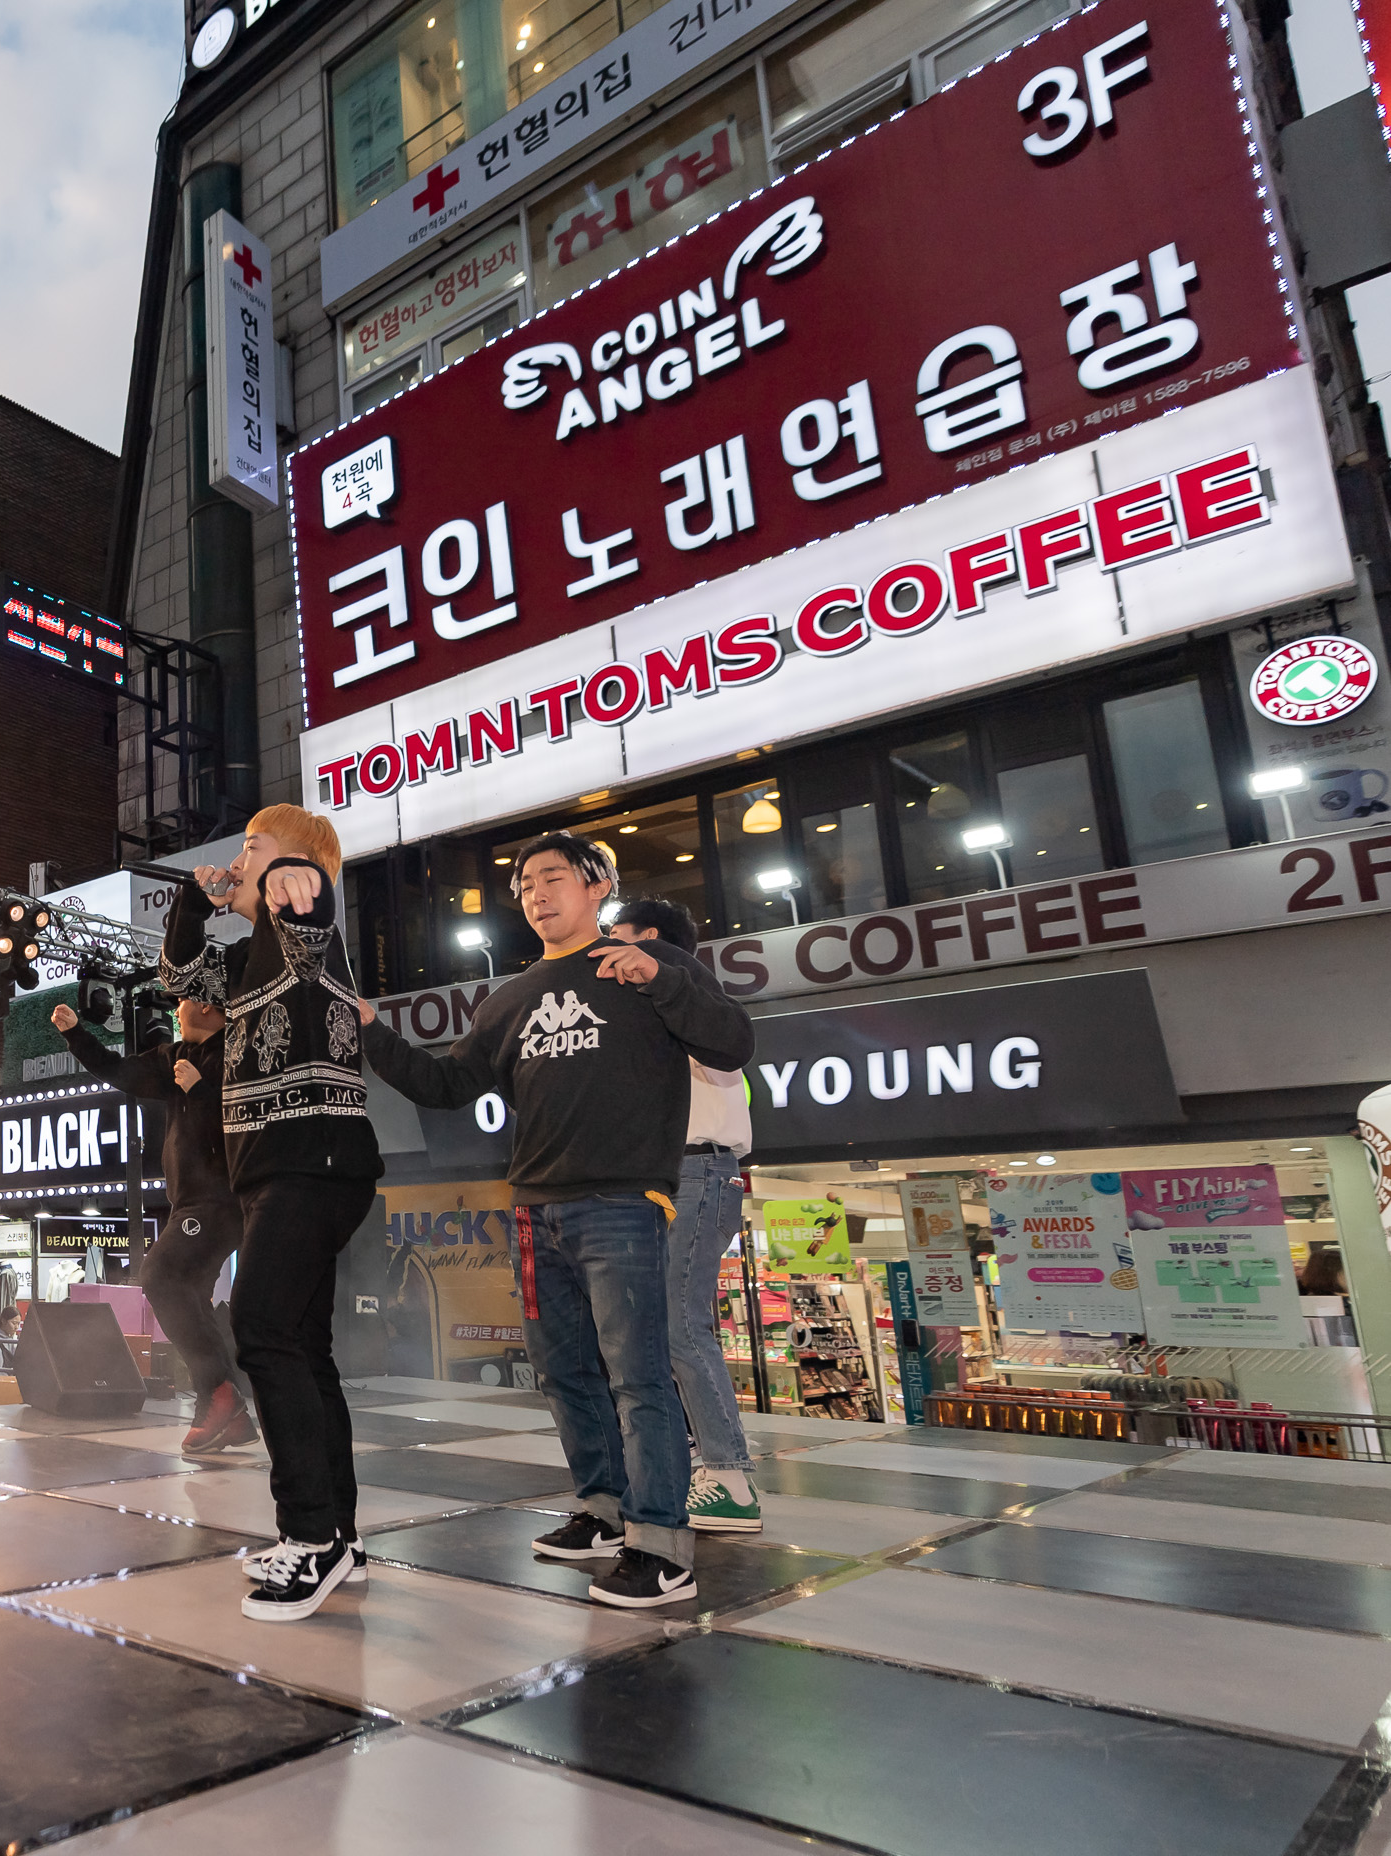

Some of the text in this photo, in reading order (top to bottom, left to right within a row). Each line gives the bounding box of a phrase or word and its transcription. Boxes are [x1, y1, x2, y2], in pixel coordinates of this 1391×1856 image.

[1016, 19, 1150, 159] 3F
[477, 52, 632, 182] 헌혈의집
[434, 241, 517, 308] 영화보자
[590, 275, 719, 373] COIN
[239, 305, 263, 455] 헌혈의집
[555, 297, 786, 441] ANGEL
[326, 242, 1197, 689] 코인 노래연습장
[331, 450, 384, 492] 천원에
[315, 443, 1273, 811] TOM N TOMS COFFEE
[1265, 681, 1367, 721] COFFEE
[794, 872, 1148, 985] COFFEE
[1279, 834, 1391, 915] 2F
[46, 964, 78, 981] COFF
[520, 1025, 601, 1060] Kappa
[757, 1036, 1043, 1109] YOUNG
[1154, 1176, 1201, 1204] FLY
[46, 1235, 90, 1248] BEAUTY
[771, 1228, 792, 1242] 나는
[1022, 1216, 1096, 1233] AWARDS
[427, 1249, 469, 1272] WANNA
[1168, 1241, 1229, 1256] 가을 부스팅
[924, 1275, 965, 1294] 증정
[494, 1327, 523, 1341] #할로
